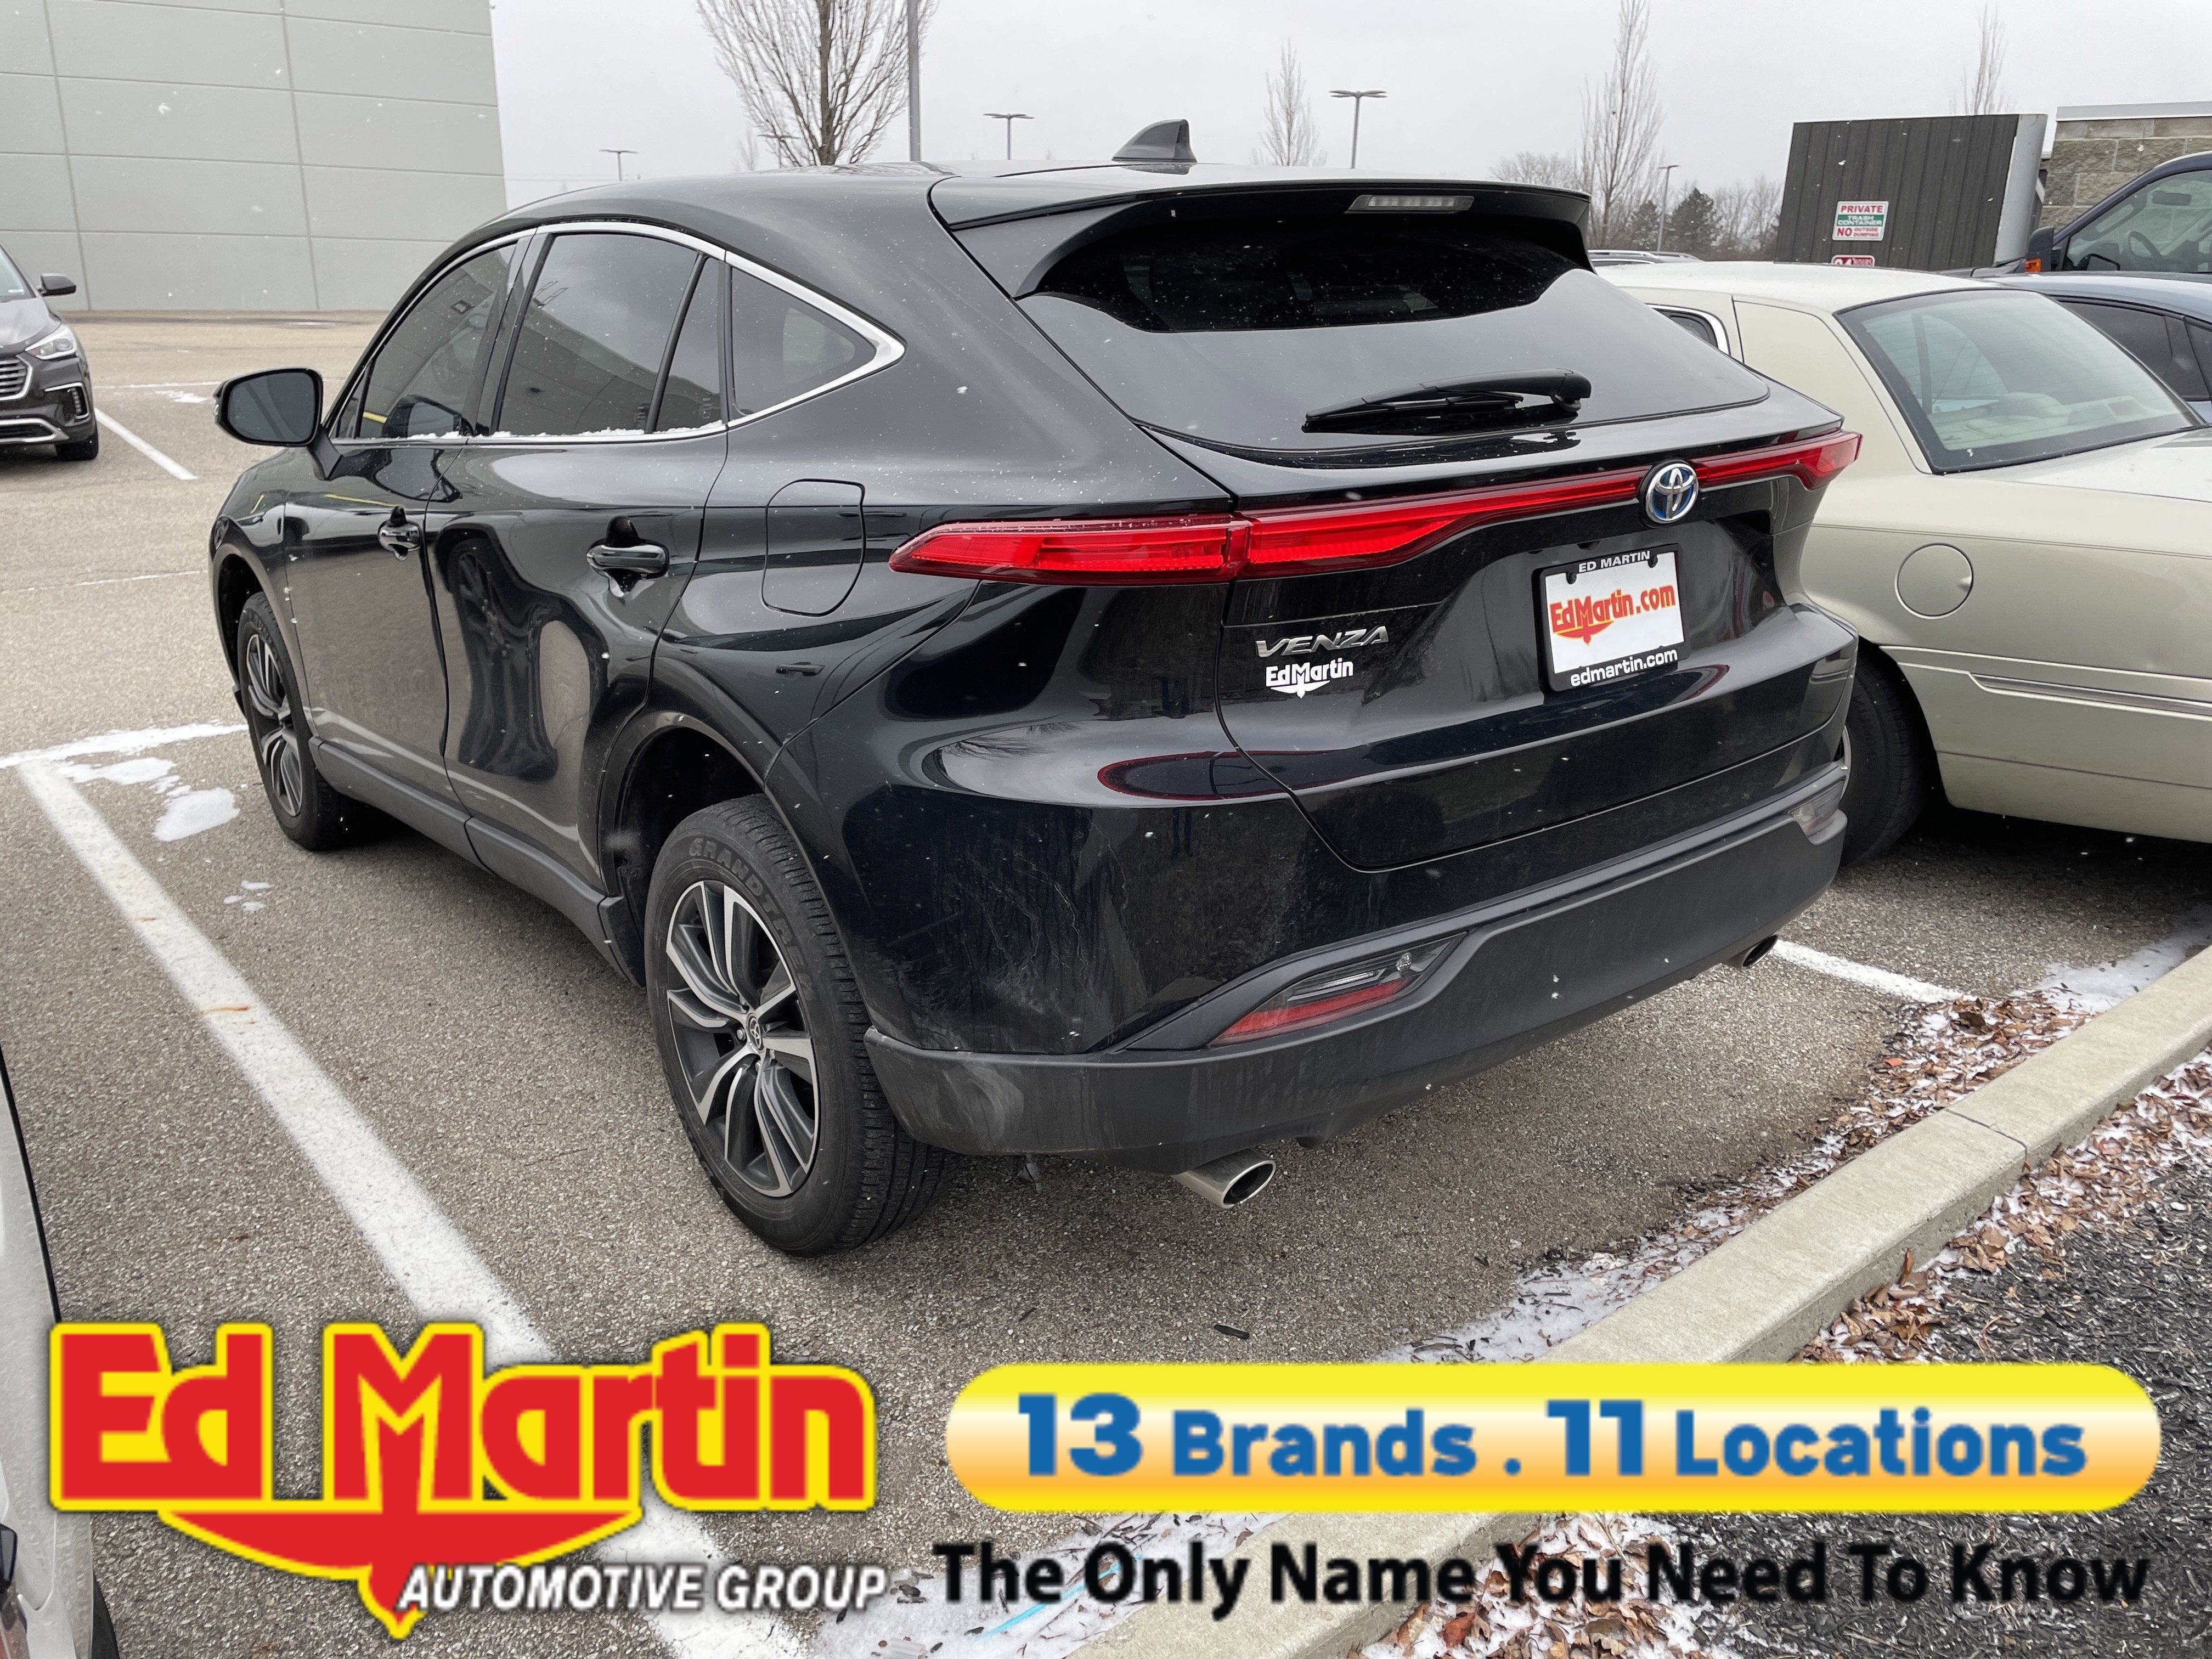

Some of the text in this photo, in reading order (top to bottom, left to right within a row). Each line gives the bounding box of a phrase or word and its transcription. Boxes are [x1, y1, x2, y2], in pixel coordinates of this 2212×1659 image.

[1837, 228, 1852, 236] NO
[1578, 550, 1650, 573] ED MARTIN
[1549, 584, 1676, 633] EdMartin.com
[1256, 625, 1389, 658] VENZA
[1570, 648, 1678, 687] edmartin.com
